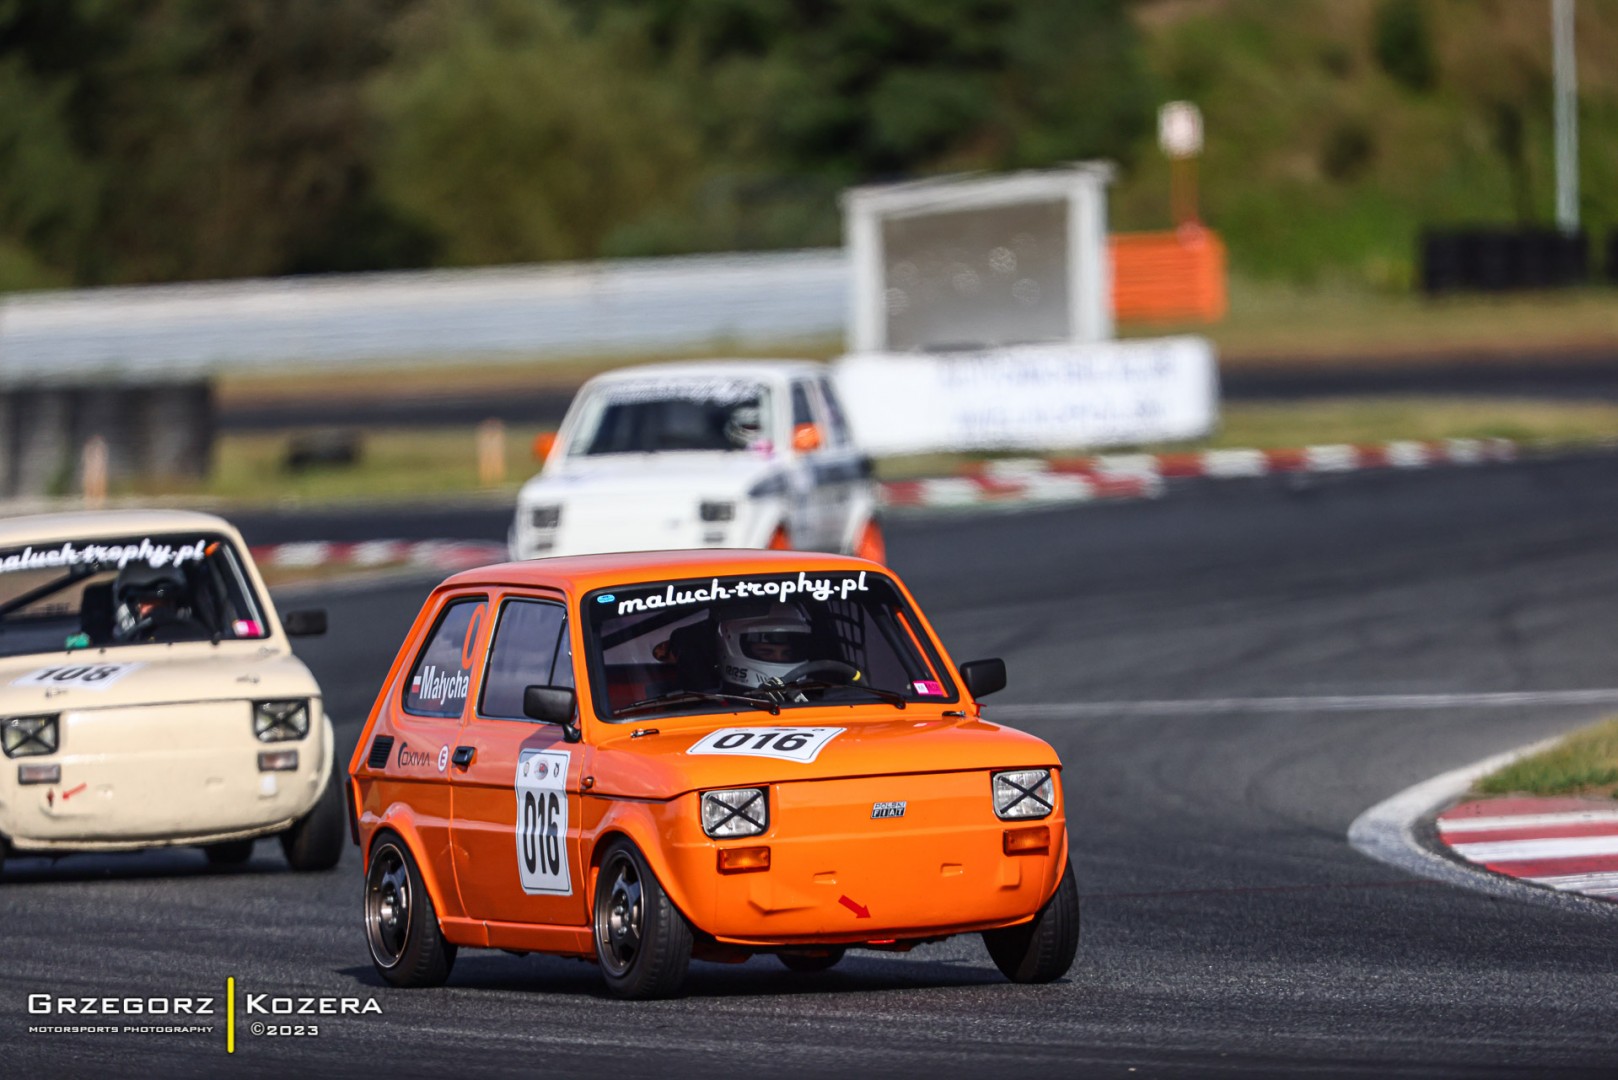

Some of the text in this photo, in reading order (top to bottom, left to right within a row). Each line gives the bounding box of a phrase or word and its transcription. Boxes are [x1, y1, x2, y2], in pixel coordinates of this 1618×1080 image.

[618, 571, 869, 615] maluch-trophy.pl
[36, 666, 121, 682] 108
[712, 732, 815, 752] 016
[872, 808, 904, 818] FIAT
[522, 790, 560, 877] 016
